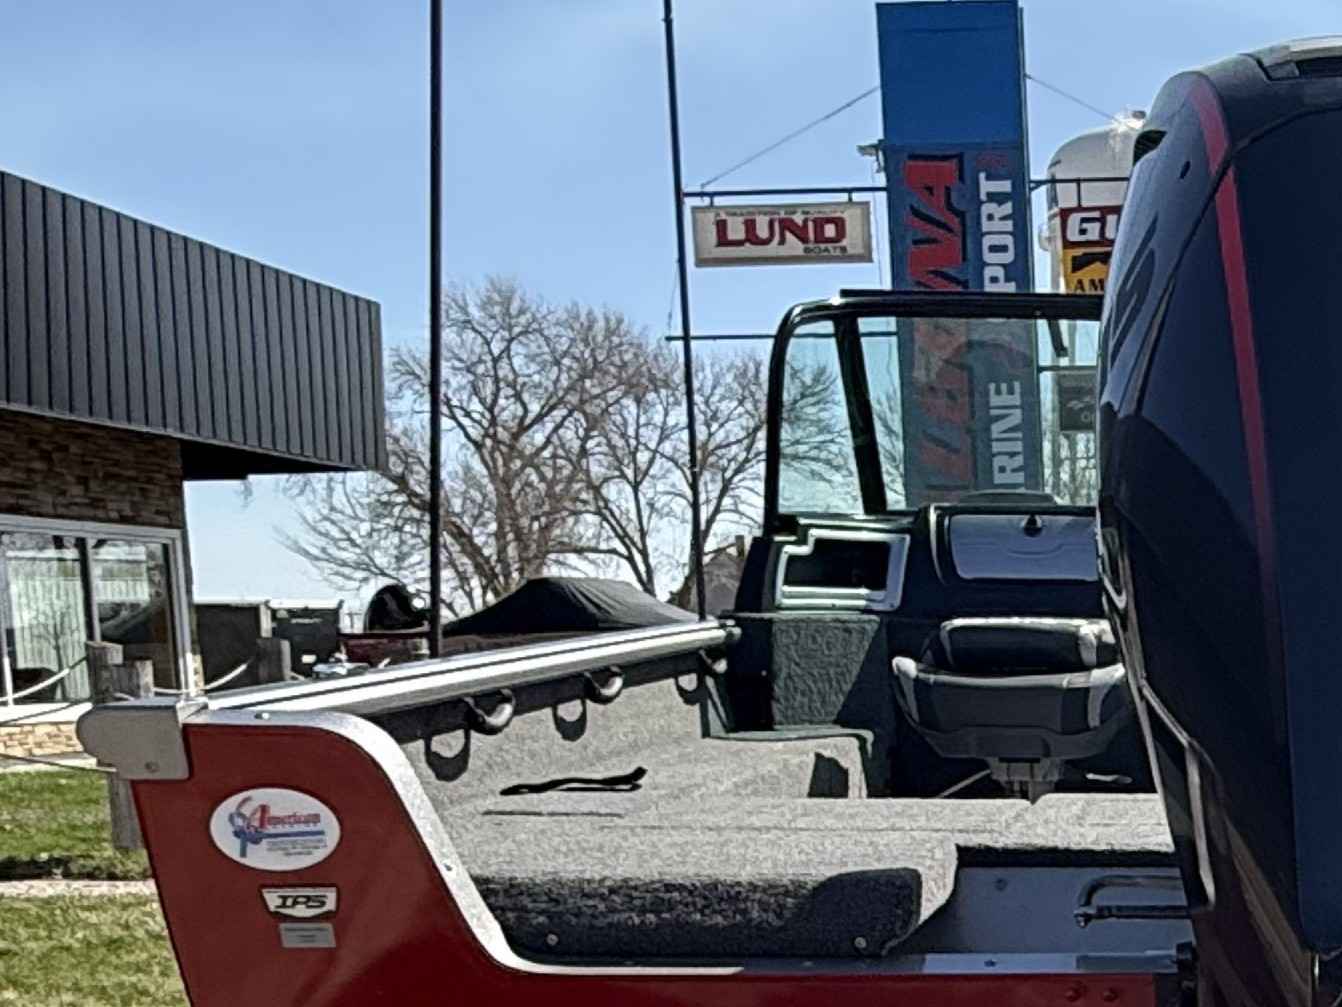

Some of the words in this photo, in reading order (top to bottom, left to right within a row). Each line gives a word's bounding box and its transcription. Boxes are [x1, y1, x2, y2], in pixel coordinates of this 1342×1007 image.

[715, 216, 847, 248] LUND
[978, 171, 1017, 293] PORT
[803, 246, 848, 255] BOATS
[1074, 278, 1105, 292] AM
[988, 381, 1026, 488] RINE
